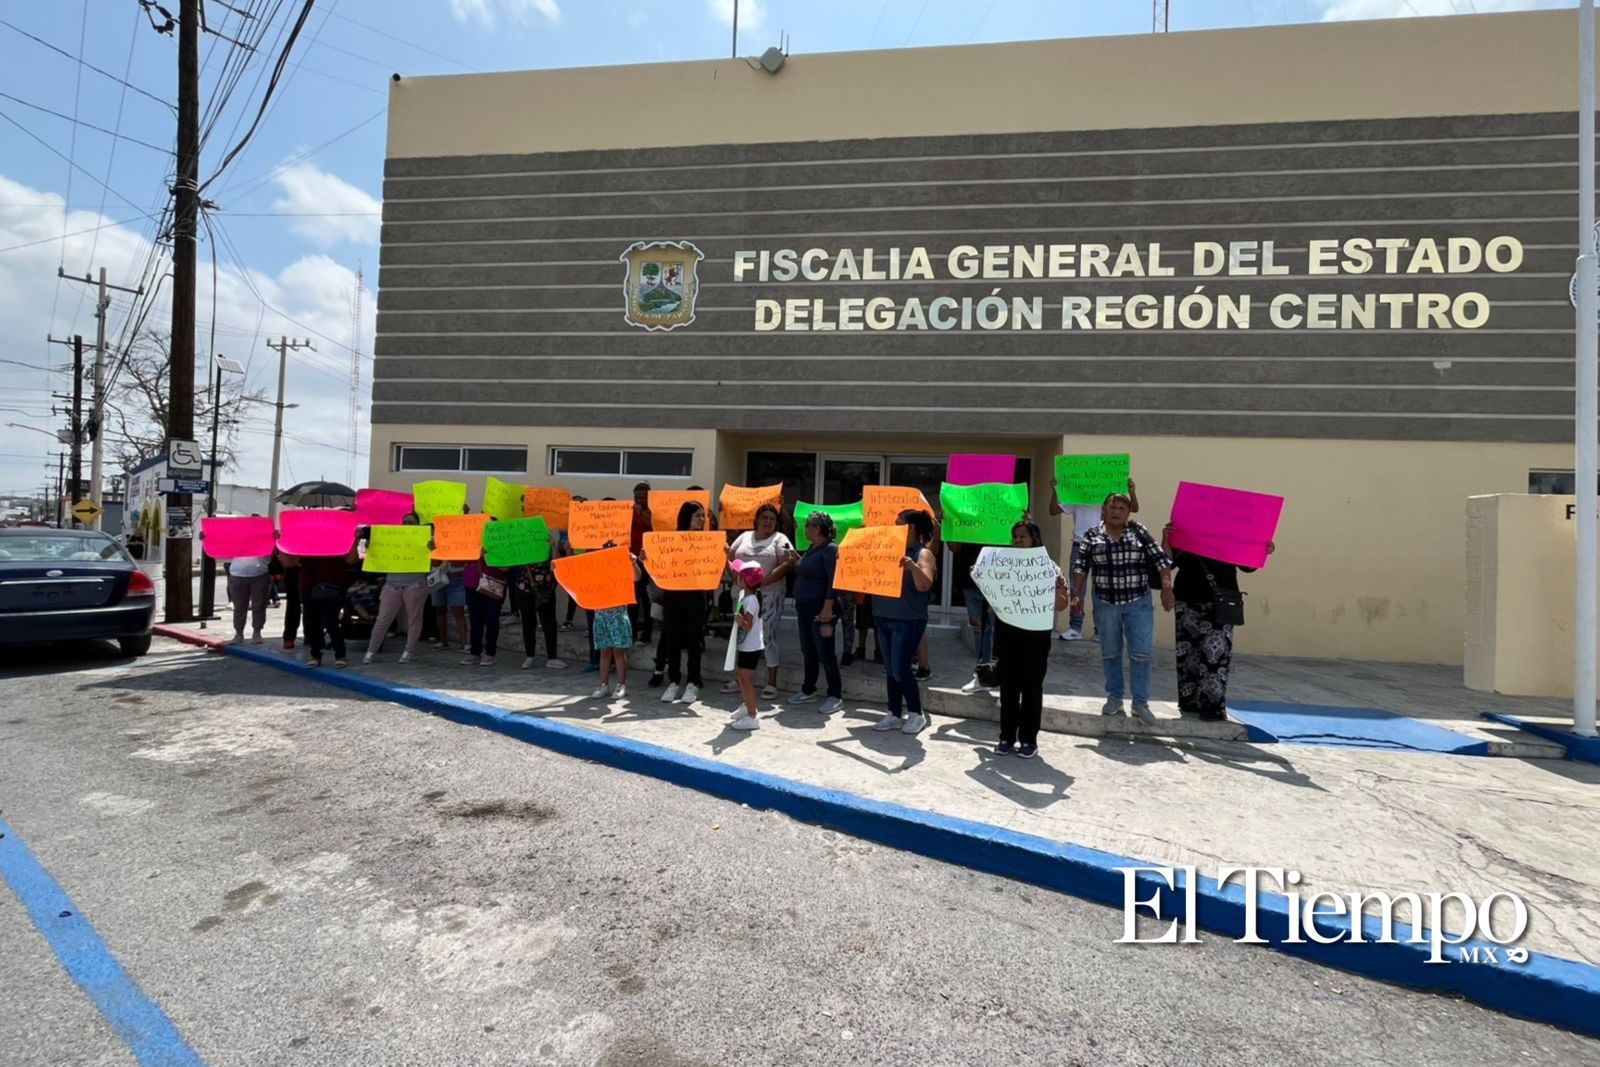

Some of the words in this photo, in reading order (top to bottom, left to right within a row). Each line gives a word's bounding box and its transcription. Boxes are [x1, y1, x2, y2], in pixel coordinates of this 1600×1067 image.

[733, 247, 935, 282] FISCALIA
[947, 242, 1175, 279] GENERAL
[1193, 240, 1290, 276] DEL
[1308, 235, 1524, 275] ESTADO
[754, 286, 1043, 331] DELEGACIÓN
[1061, 284, 1251, 330] REGIÓN
[1269, 292, 1491, 329] CENTRO
